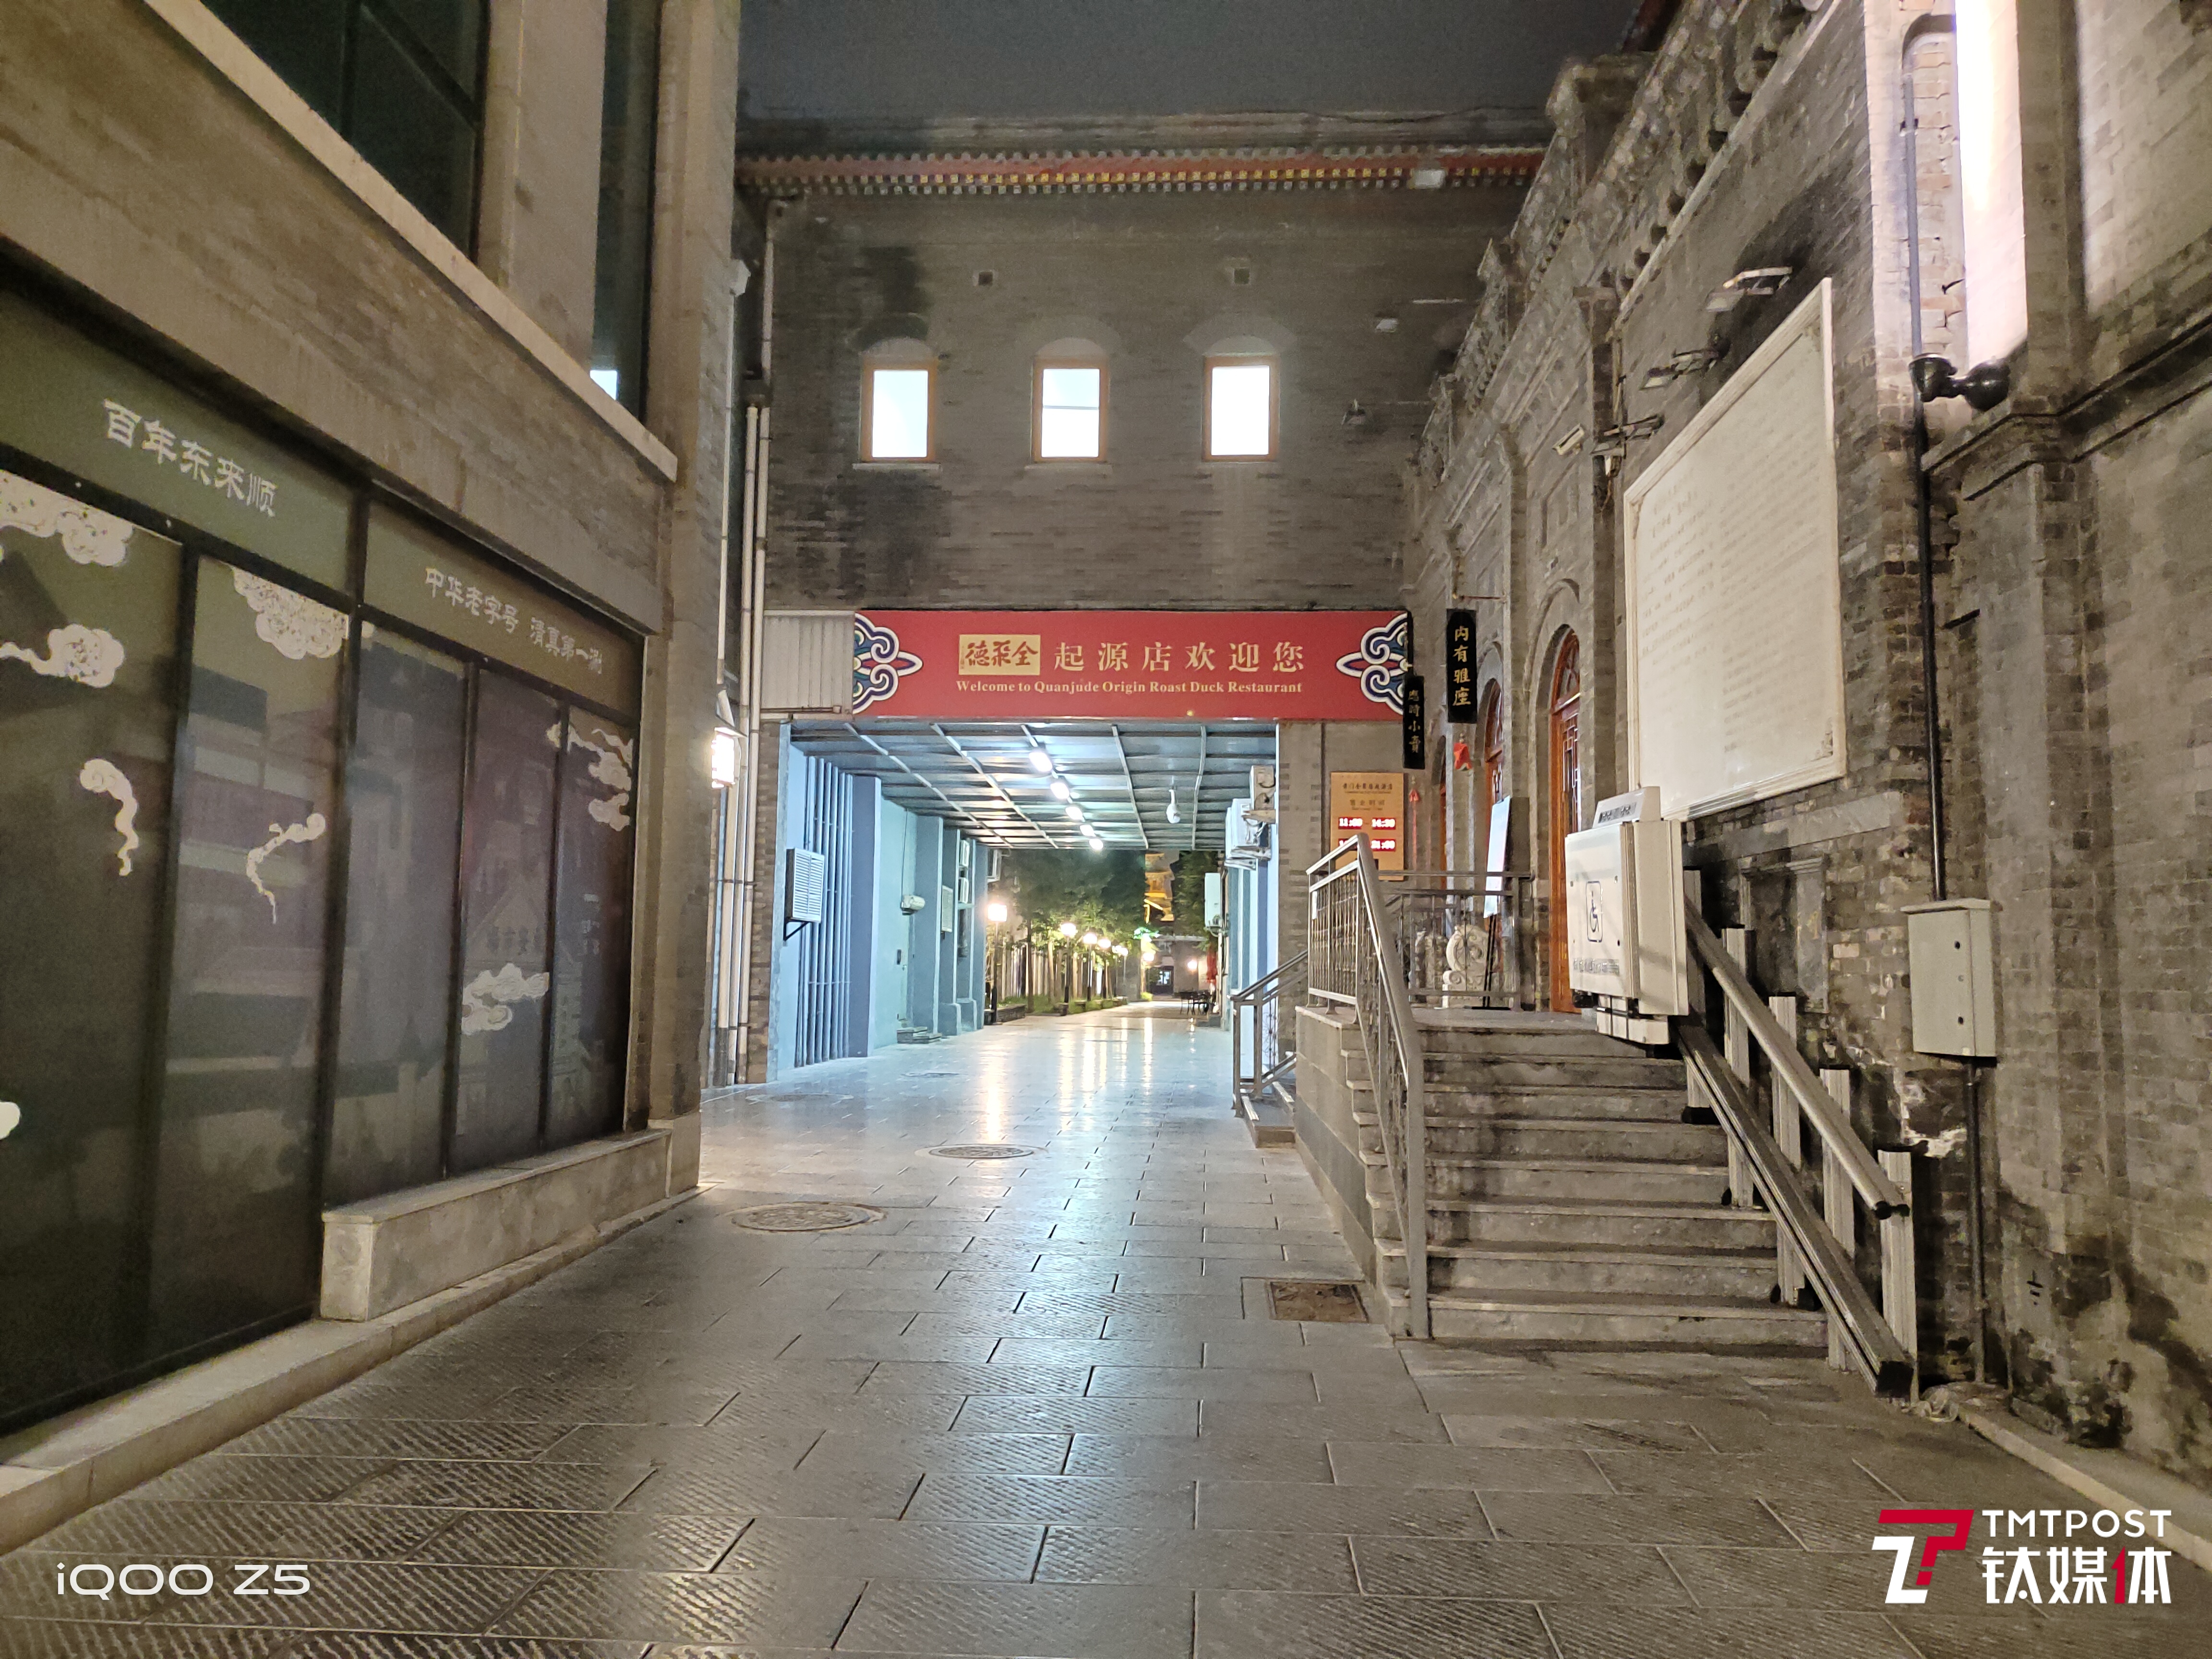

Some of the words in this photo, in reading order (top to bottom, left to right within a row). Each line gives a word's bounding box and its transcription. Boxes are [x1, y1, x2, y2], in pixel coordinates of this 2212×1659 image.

[104, 398, 277, 517] 百年东来顺
[425, 567, 518, 634] 中华老字号
[956, 680, 1015, 692] Welcome
[1018, 682, 1031, 693] to
[1034, 681, 1099, 695] Quanjude
[1102, 681, 1145, 695] Origin
[1149, 681, 1186, 693] Roast
[1190, 681, 1225, 693] Duck
[1228, 681, 1302, 693] Restaurant
[1054, 642, 1304, 673] 起源店欢迎您
[1453, 625, 1471, 706] 内有雅座
